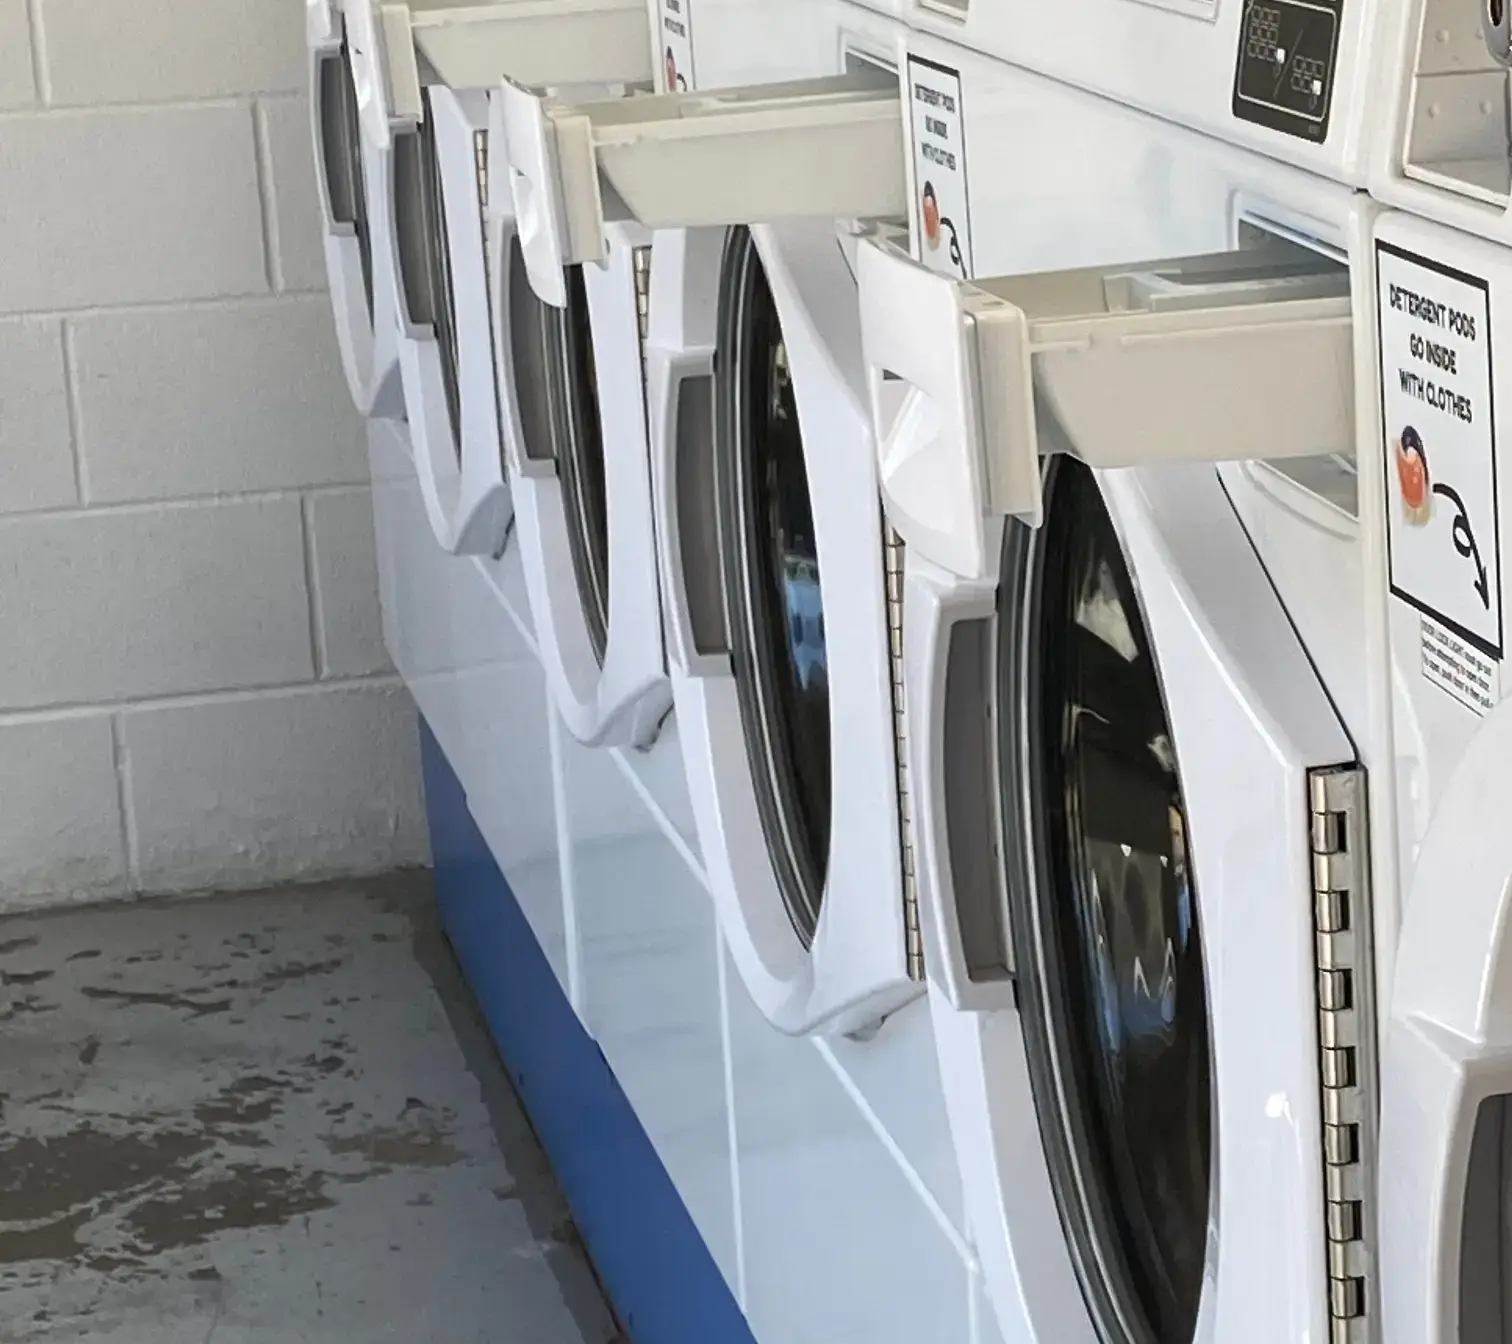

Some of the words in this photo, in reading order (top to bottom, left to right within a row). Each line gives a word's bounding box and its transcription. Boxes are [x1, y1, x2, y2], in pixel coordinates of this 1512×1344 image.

[1390, 283, 1446, 328] DETERGENT
[1448, 307, 1476, 341] PODS
[1410, 333, 1424, 360] GO
[1426, 340, 1457, 375] INSIDE
[1398, 368, 1424, 402] WITH
[1426, 381, 1473, 423] CLOTHES
